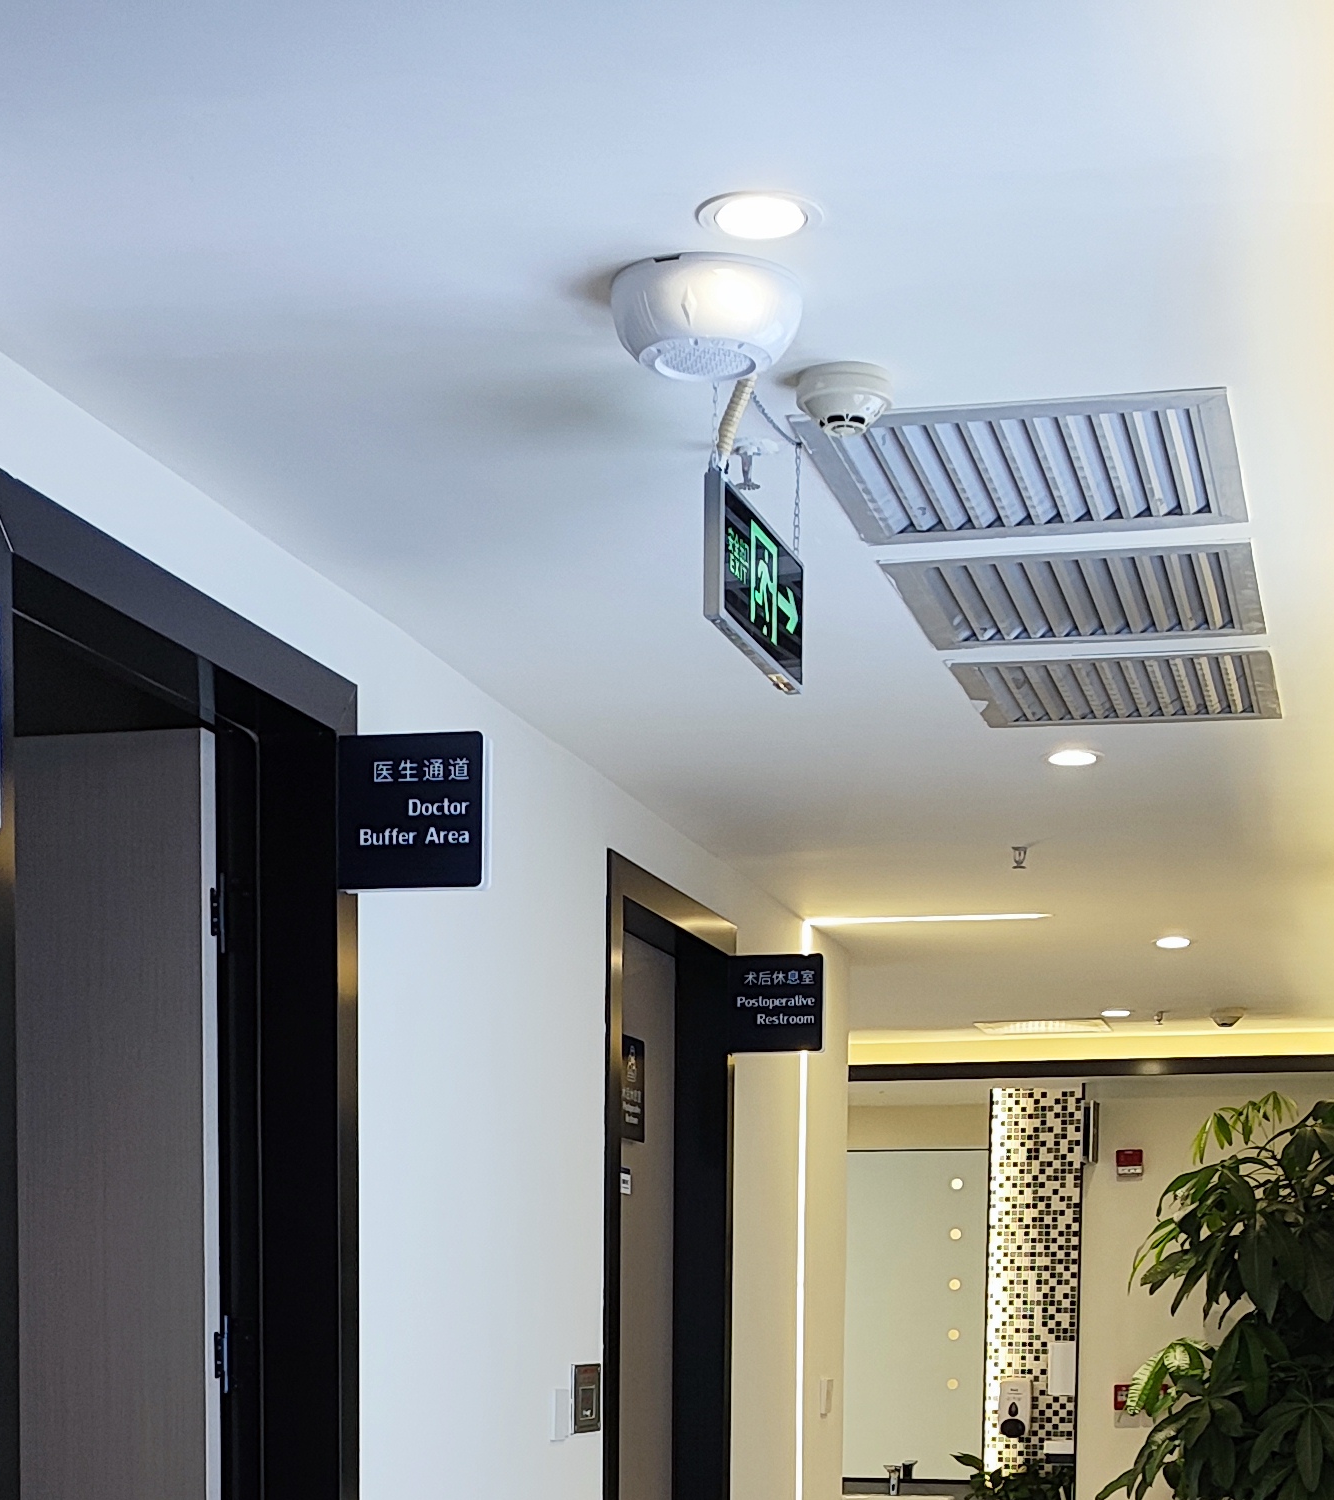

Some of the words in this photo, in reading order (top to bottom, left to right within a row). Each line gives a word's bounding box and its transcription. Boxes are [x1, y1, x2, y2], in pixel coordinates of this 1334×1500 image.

[729, 553, 747, 585] EXIT
[373, 757, 470, 783] 医生通道
[408, 798, 470, 816] Doctor
[359, 828, 417, 846] Buffer
[424, 827, 470, 844] Area
[743, 969, 815, 986] 术后休息室
[736, 995, 815, 1010] Postoperative
[756, 1013, 815, 1025] Restroom
